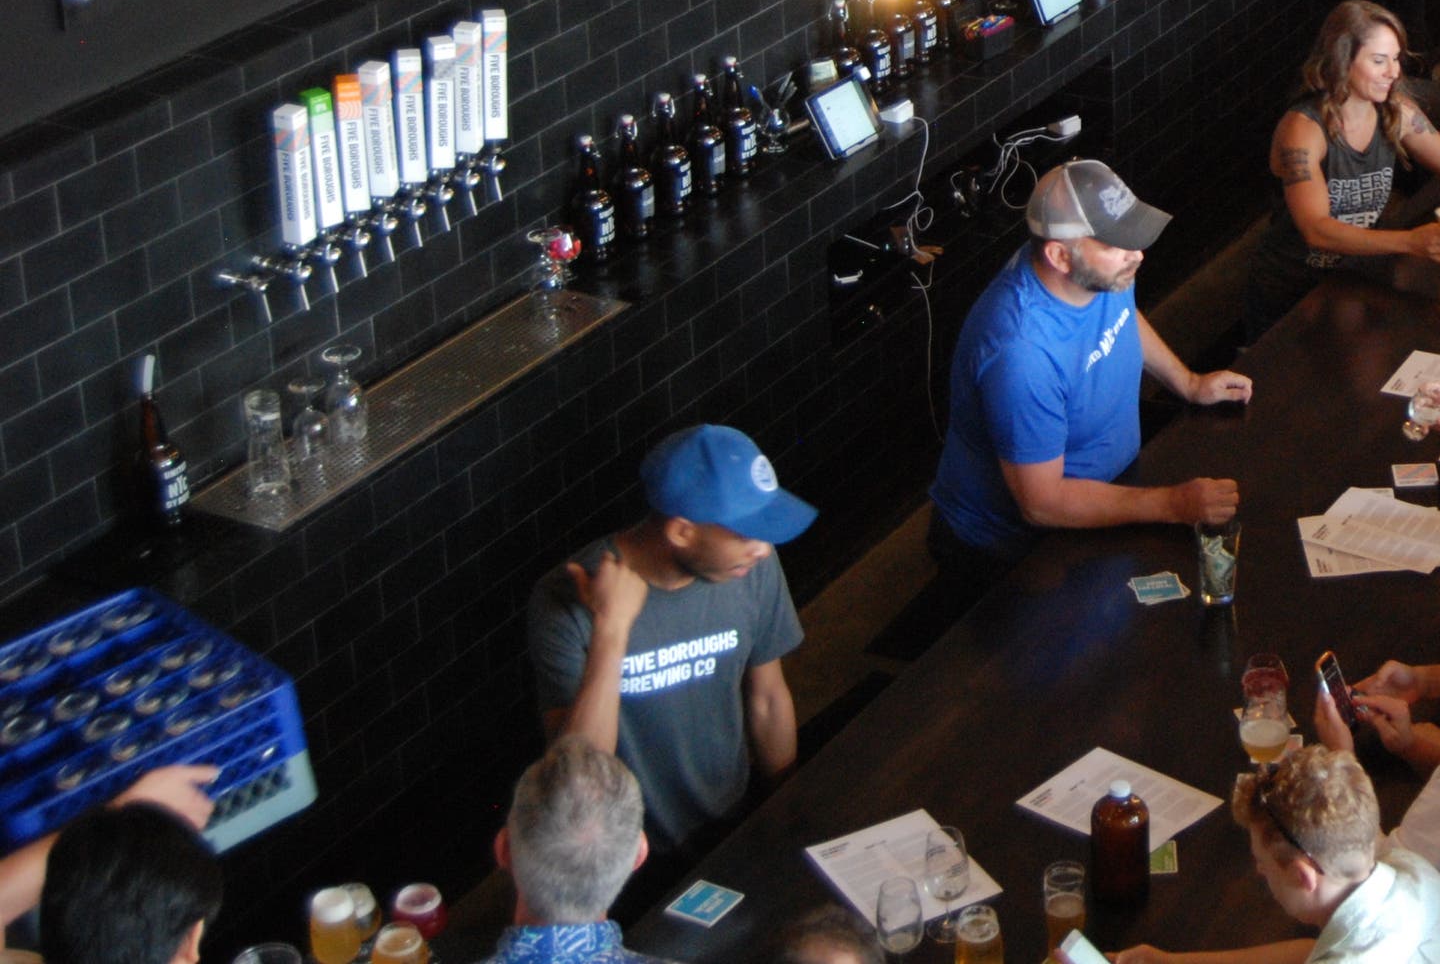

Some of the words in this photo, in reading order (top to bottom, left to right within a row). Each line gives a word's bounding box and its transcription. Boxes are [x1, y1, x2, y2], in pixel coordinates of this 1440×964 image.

[460, 67, 469, 86] FIVE
[490, 54, 499, 73] FIVE
[405, 95, 416, 115] FIVE
[438, 82, 447, 101] FIVE
[460, 87, 471, 131] BOROUGHS
[490, 74, 501, 118] BOROUGHS
[346, 121, 356, 142] FIVE
[368, 108, 378, 127] FIVE
[438, 102, 448, 147] BOROUGHS
[320, 134, 330, 154] FIVE
[371, 129, 384, 174] BOROUGHS
[407, 116, 419, 161] BOROUGHS
[322, 156, 336, 204] BOROUGHS
[349, 143, 362, 189] BOROUGHS
[621, 651, 656, 676] FIVE
[658, 629, 738, 668] BOROUGHS
[621, 663, 692, 694] BREWING
